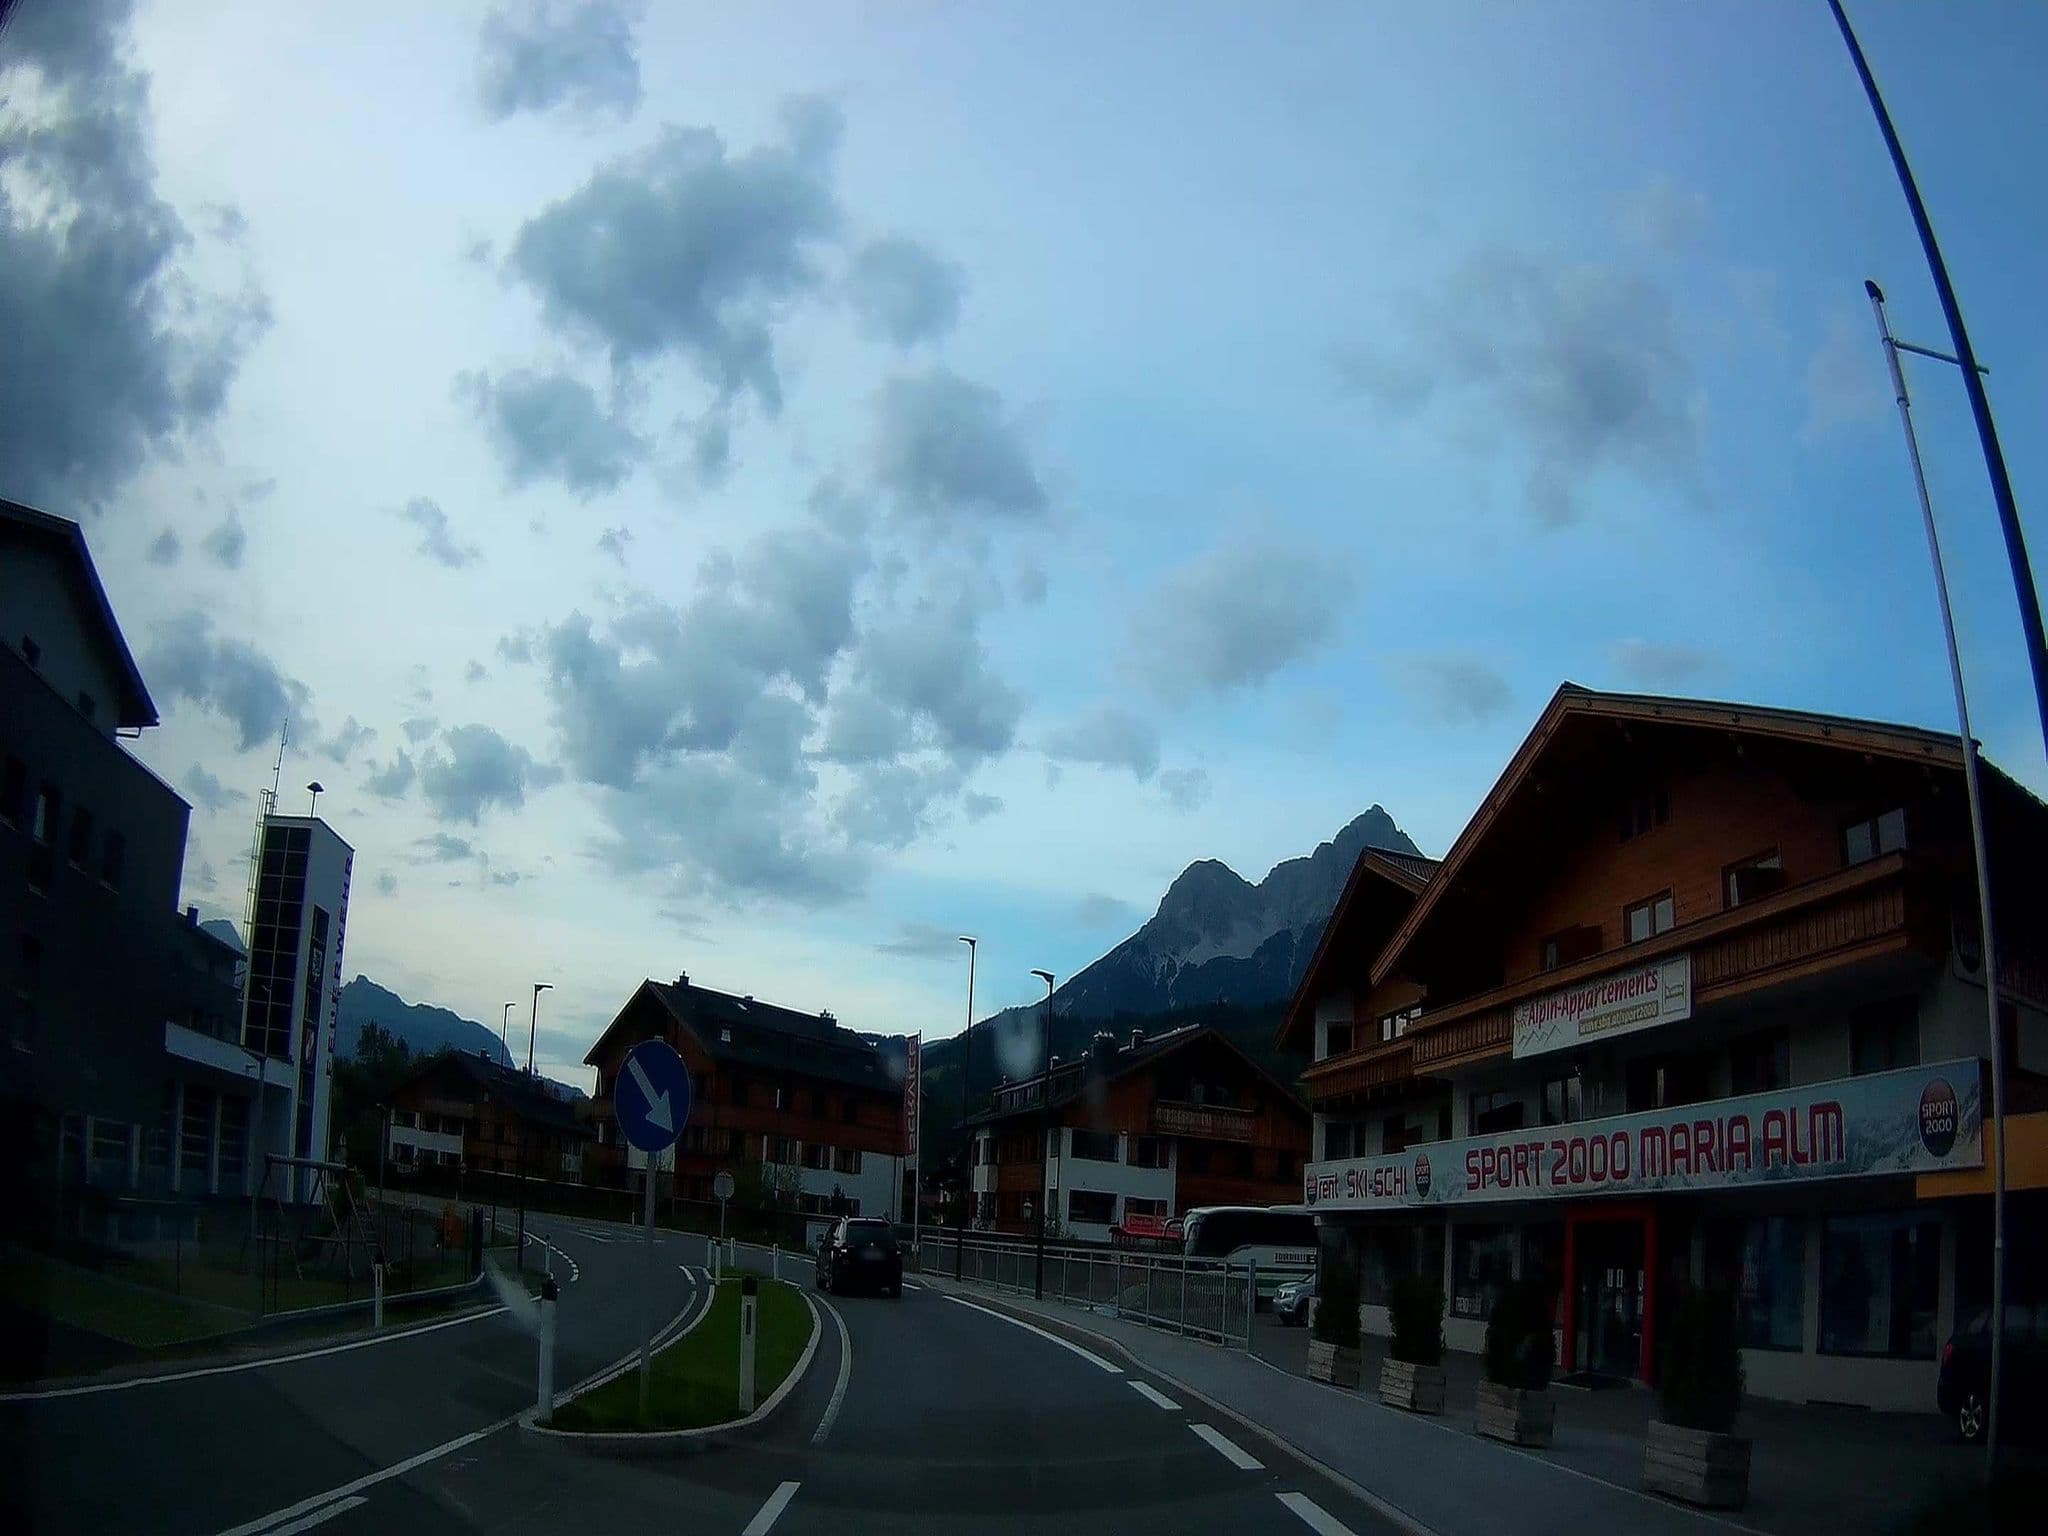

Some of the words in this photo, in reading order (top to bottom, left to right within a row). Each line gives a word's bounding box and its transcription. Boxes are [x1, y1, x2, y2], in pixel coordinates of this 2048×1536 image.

[1528, 971, 1658, 1029] Alpin-Appartements
[1922, 1100, 1955, 1118] SPORT
[1926, 1118, 1952, 1135] 2000
[1466, 1142, 1545, 1190] SPORT
[1551, 1131, 1630, 1185] 2000
[1640, 1114, 1751, 1178] MARIA
[1763, 1101, 1844, 1168] ALM
[1319, 1173, 1339, 1200] rent
